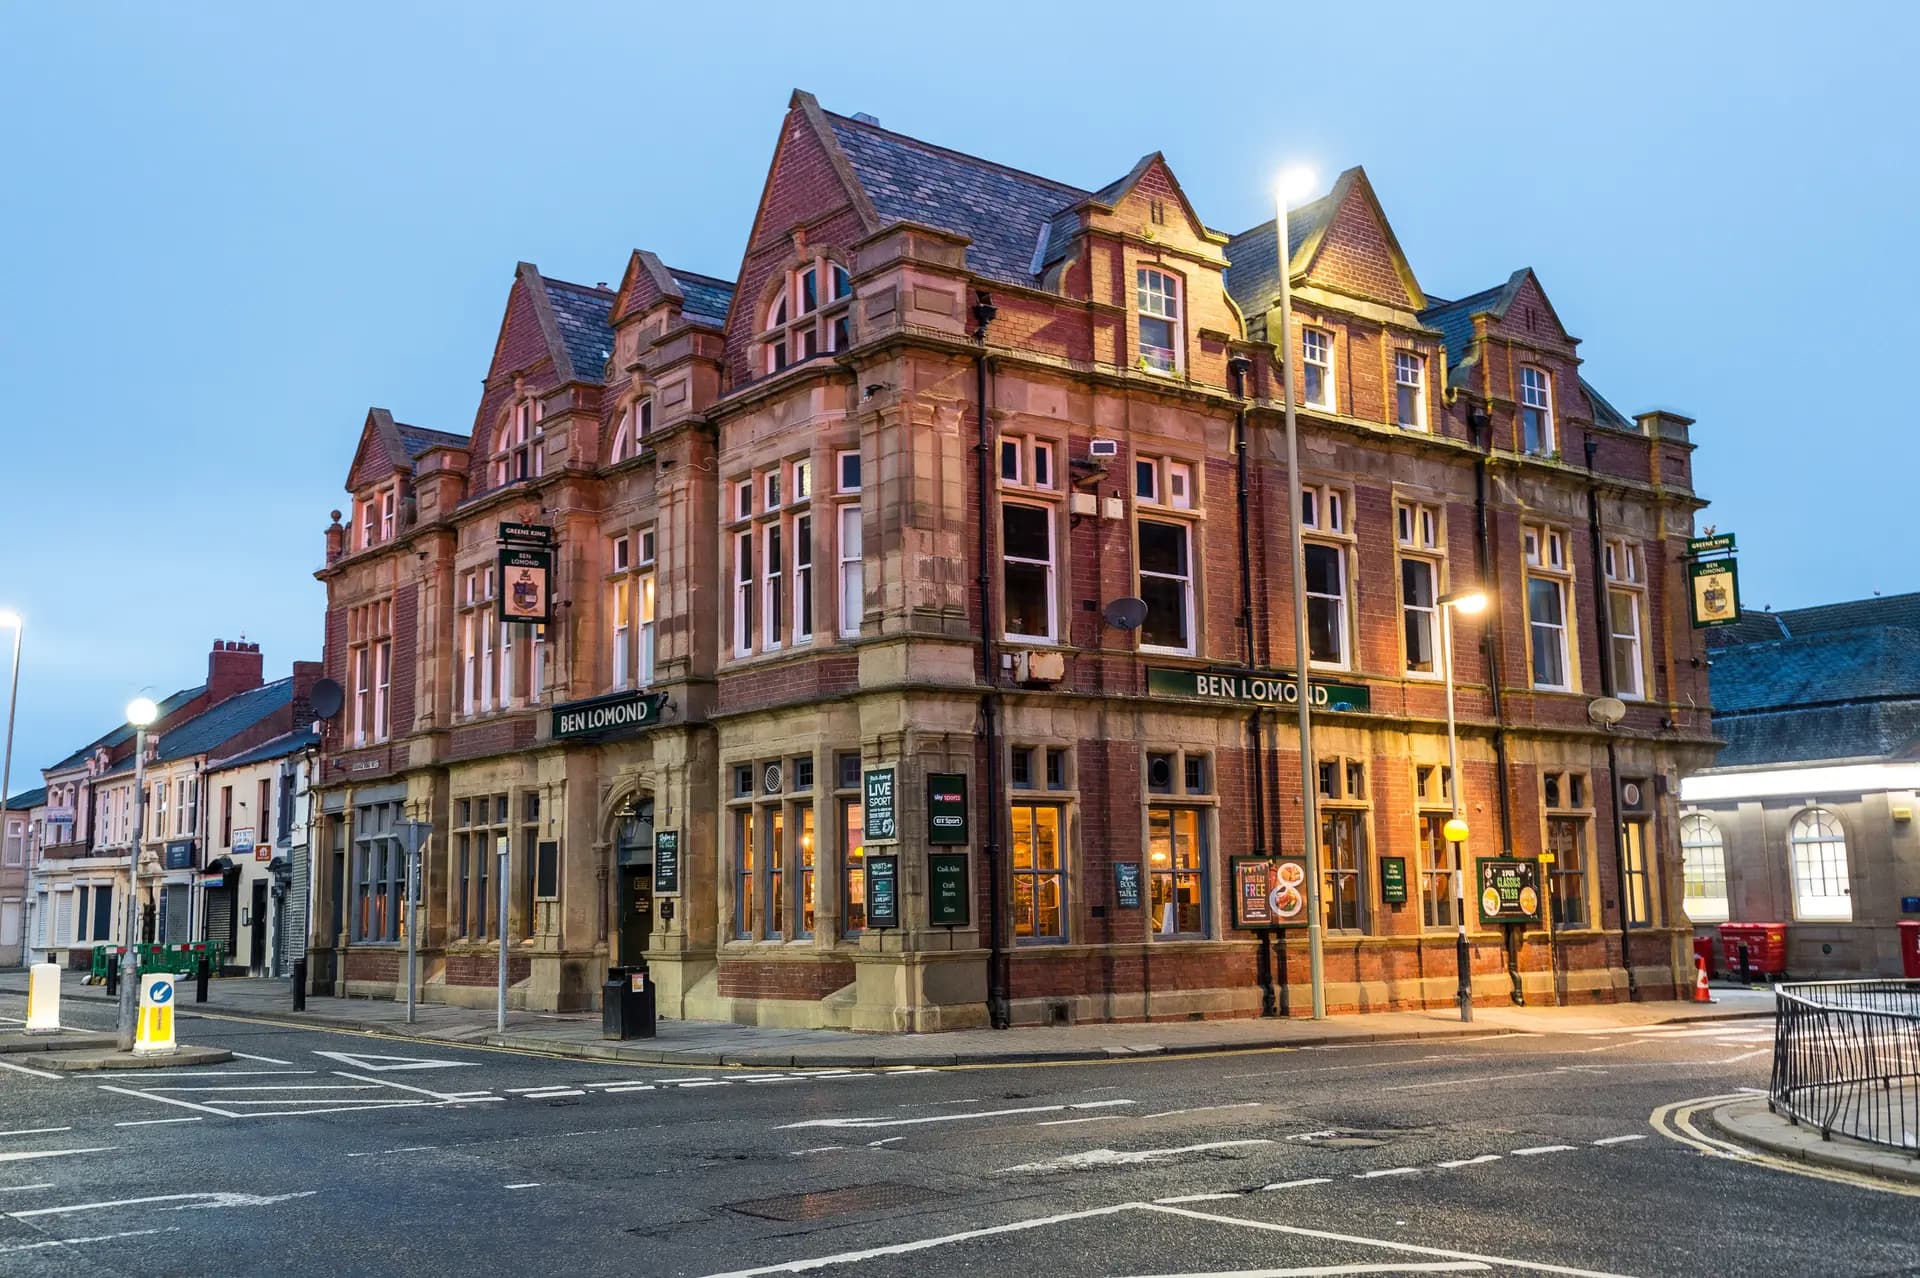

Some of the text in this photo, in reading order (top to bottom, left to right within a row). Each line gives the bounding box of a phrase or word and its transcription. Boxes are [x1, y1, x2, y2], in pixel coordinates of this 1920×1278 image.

[505, 527, 529, 535] GREENE
[1691, 541, 1714, 549] GREENE
[511, 558, 539, 566] LOMOND
[1699, 567, 1726, 576] LOMOND
[1196, 675, 1236, 698] BEN
[560, 701, 648, 733] BEN LOMOND
[868, 782, 892, 797] LIVE
[869, 797, 892, 807] SPORT
[945, 817, 960, 825] Sport
[1496, 876, 1521, 888] CLASSICS
[1245, 883, 1266, 897] FREE
